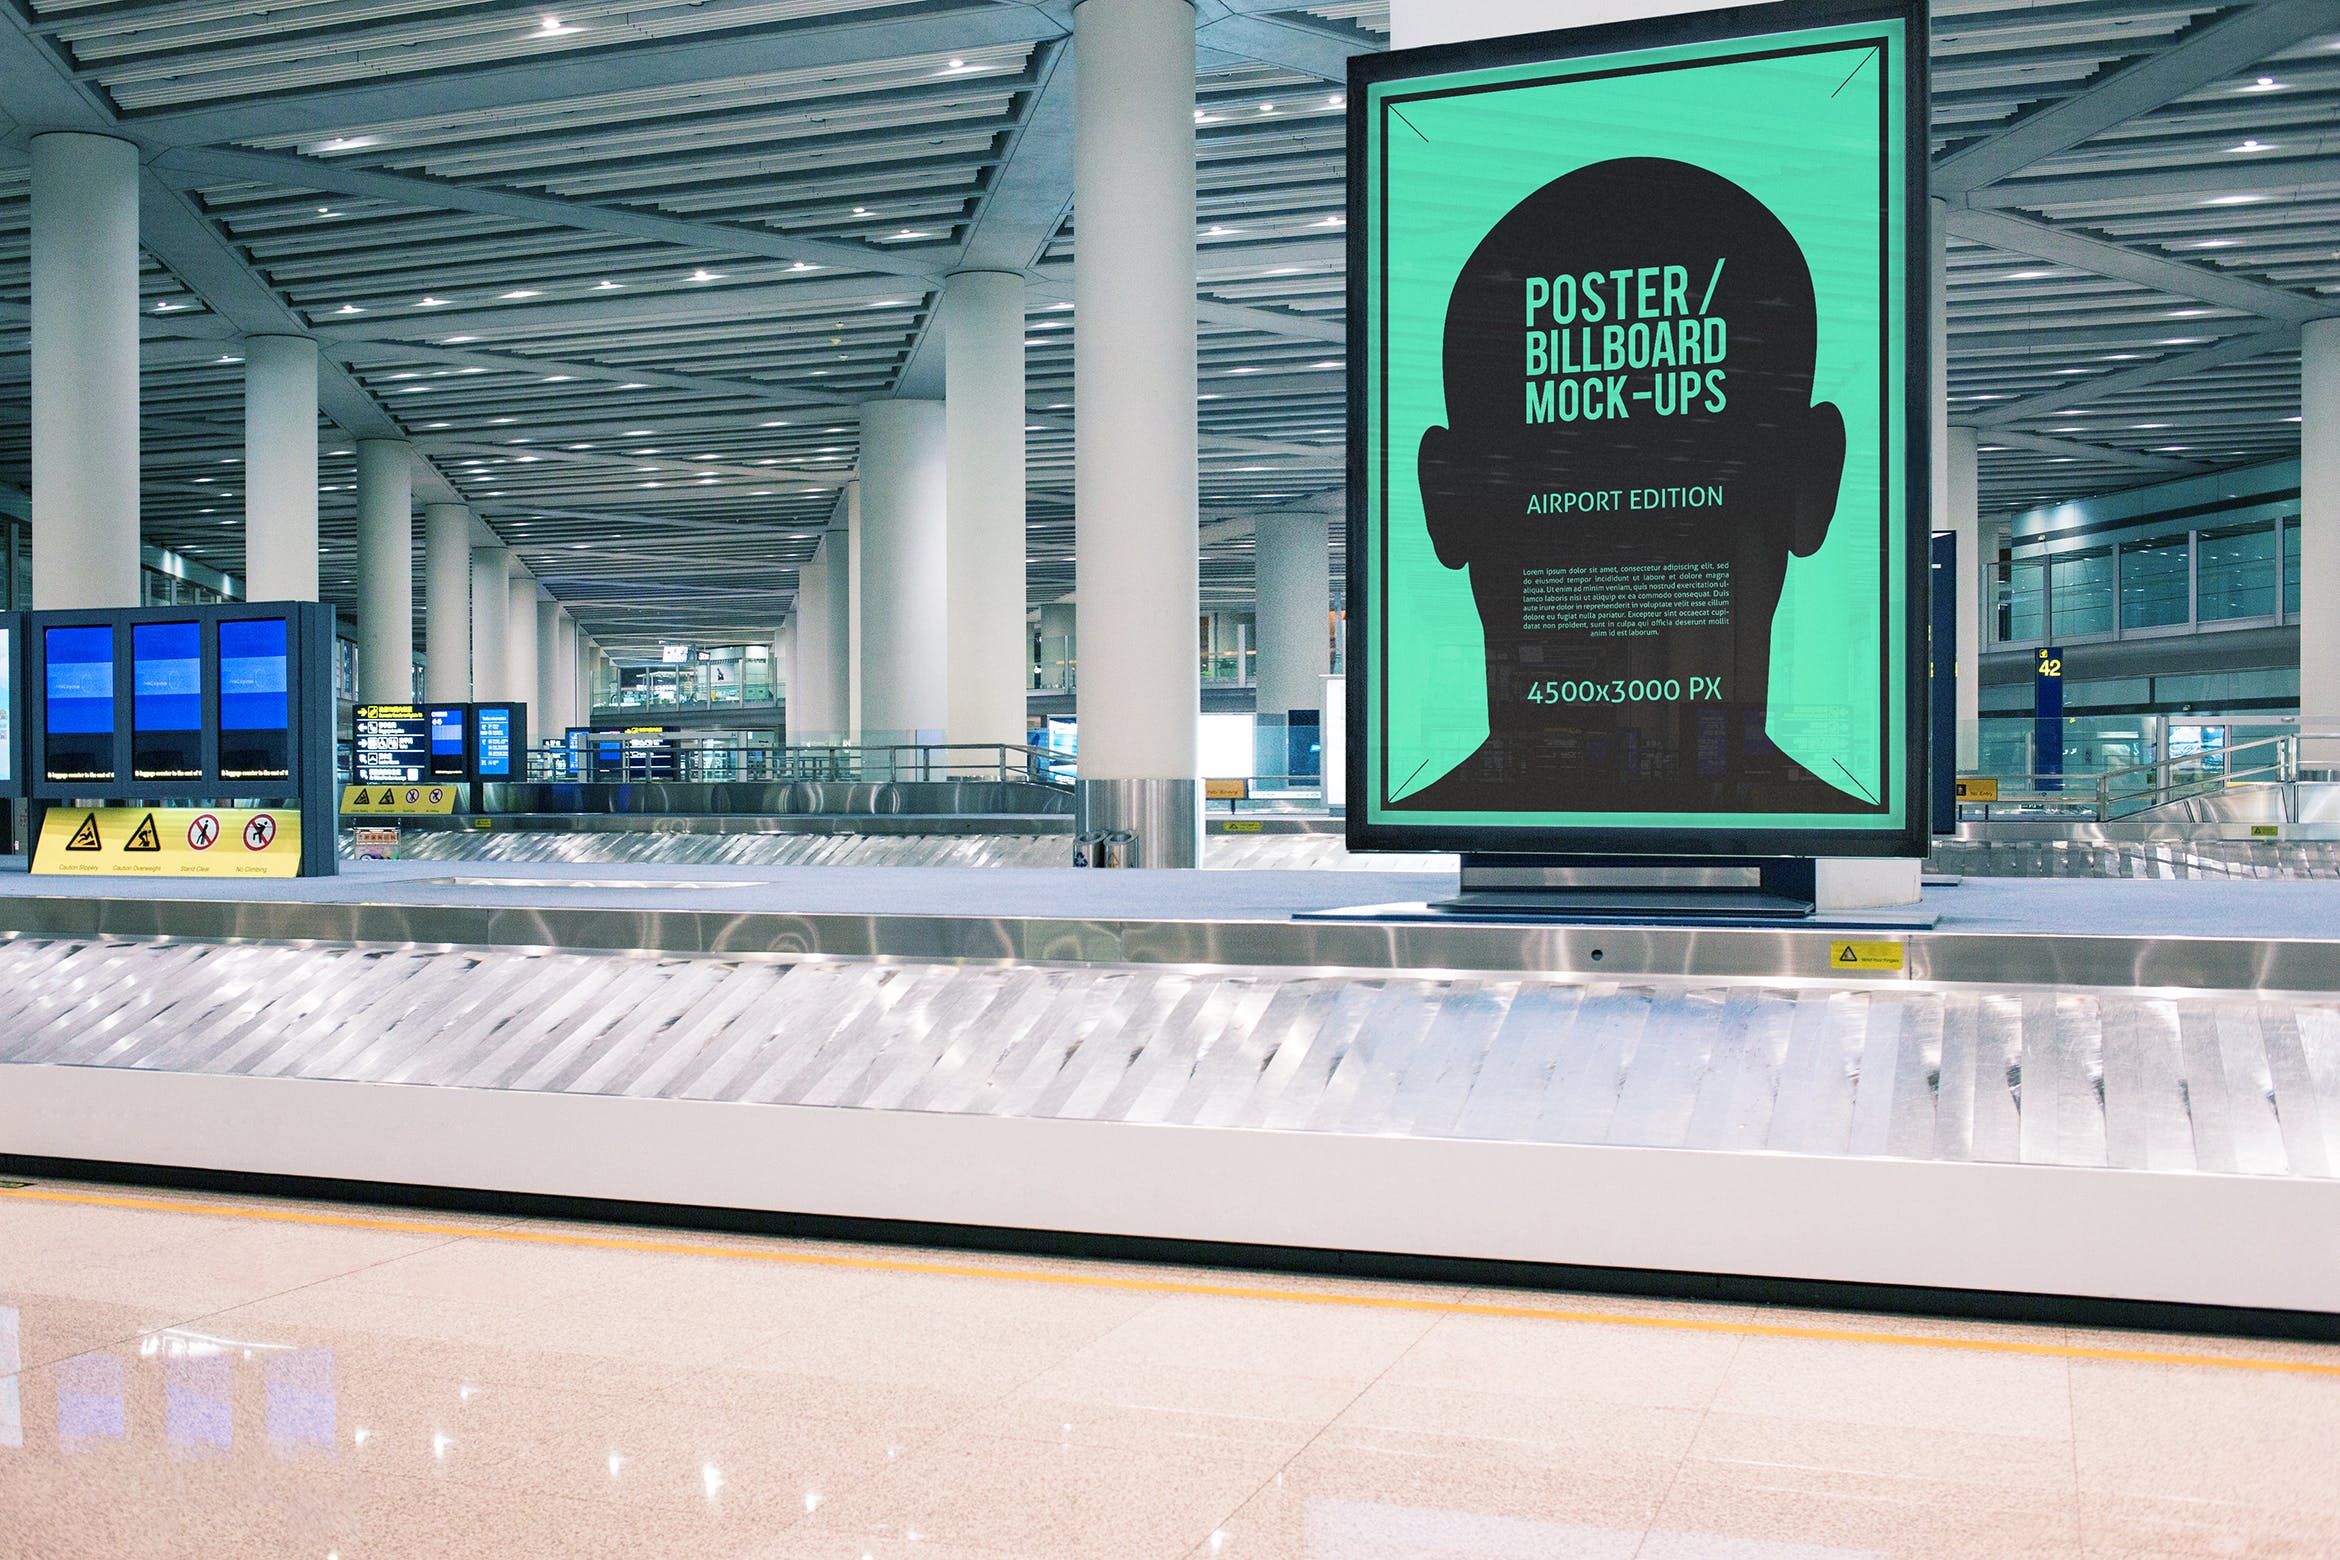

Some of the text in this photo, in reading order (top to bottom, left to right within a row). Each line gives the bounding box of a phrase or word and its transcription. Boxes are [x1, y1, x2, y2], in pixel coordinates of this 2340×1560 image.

[1526, 257, 1726, 327] POSTER /
[1526, 317, 1727, 376] BILLBOARD
[1525, 369, 1727, 424] MOCK-UPS
[1526, 485, 1724, 514] AIRPORT EDITION
[1546, 567, 1566, 576] ipsum
[1569, 566, 1587, 574] dolor
[1663, 563, 1698, 573] adipiscing
[1701, 562, 1714, 570] elit,
[1535, 576, 1563, 584] eiusmod
[1567, 577, 1591, 585] tempor
[1595, 574, 1629, 582] incididunt
[1644, 573, 1665, 581] labore
[1680, 572, 1702, 580] dolore
[1523, 586, 1545, 595] aliqua.
[1546, 585, 1554, 593] Ut
[1583, 584, 1604, 592] minim
[1606, 583, 1632, 591] veniam,
[1633, 583, 1647, 592] quis
[1649, 582, 1675, 590] nostrud
[1677, 581, 1718, 589] exercitation
[1720, 580, 1729, 588] ul-
[1545, 594, 1567, 602] laboris
[1593, 593, 1616, 602] aliquip
[1638, 591, 1672, 599] commodo
[1674, 591, 1711, 599] consequat.
[1584, 602, 1630, 611] reprehenderit
[1632, 601, 1638, 609] in
[1640, 601, 1672, 610] voluptate
[1707, 599, 1729, 607] cillum
[1557, 612, 1577, 621] fugiat
[1579, 611, 1596, 619] nulla
[1598, 611, 1626, 620] pariatur.
[1628, 611, 1661, 619] Excepteur
[1679, 609, 1709, 617] occaecat
[1711, 608, 1729, 617] cupi-
[1558, 621, 1588, 630] proident,
[1617, 620, 1635, 629] culpa
[1638, 619, 1649, 629] qui
[1629, 628, 1659, 636] laborum.
[2038, 659, 2062, 677] 42
[1527, 677, 1722, 704] 4500x3000 PX
